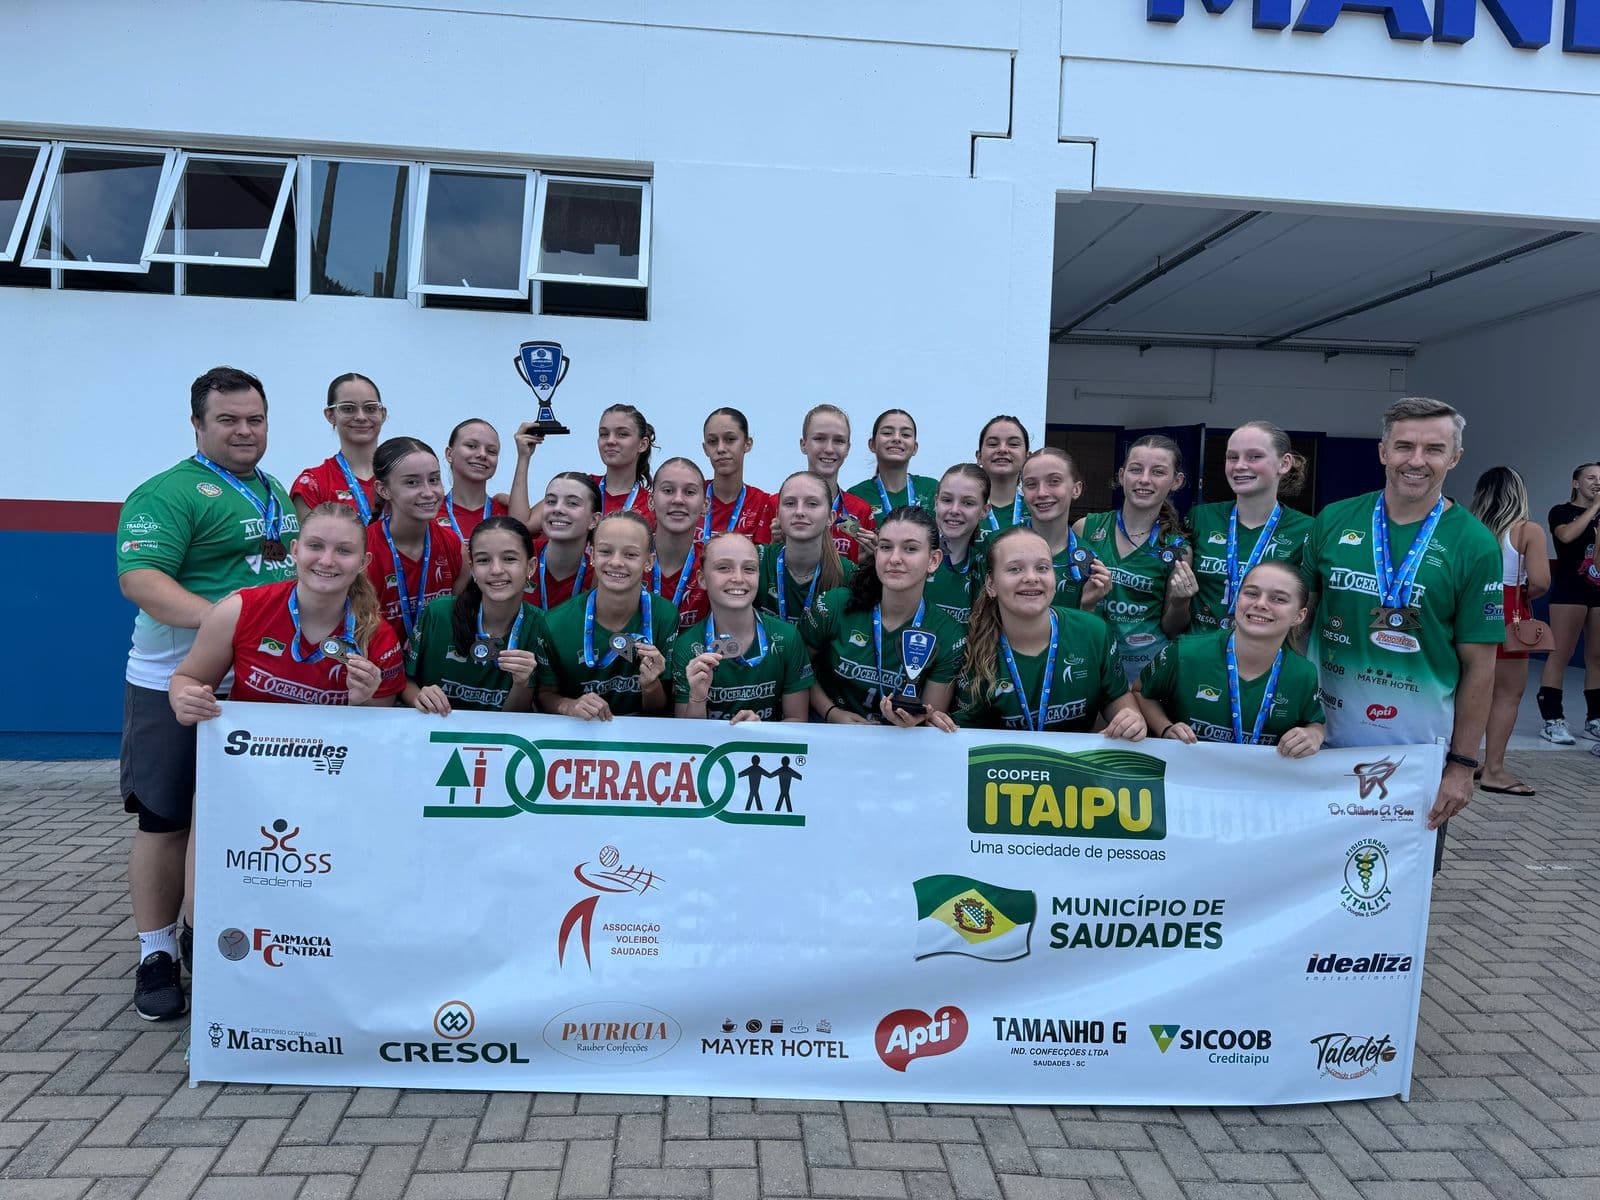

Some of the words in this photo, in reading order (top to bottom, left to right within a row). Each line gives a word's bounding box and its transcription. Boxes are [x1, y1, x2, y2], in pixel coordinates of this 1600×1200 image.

[1357, 673, 1388, 687] MAYER
[1390, 681, 1420, 693] HOTEL
[1369, 707, 1392, 717] Apti
[224, 730, 348, 759] Saudades
[252, 736, 324, 744] SUPERMERCADO
[987, 768, 1050, 782] COOPER
[985, 782, 1152, 832] ITAIPU
[970, 839, 1004, 855] Uma
[1007, 841, 1080, 858] sociedade
[1084, 845, 1103, 859] de
[1107, 848, 1166, 862] pessoas
[1346, 838, 1390, 857] FISIOTERAPIA
[242, 875, 313, 888] academia
[1051, 894, 1187, 917] MUNICÍPIO
[1192, 899, 1225, 916] DE
[1340, 885, 1392, 911] VITALITY
[602, 922, 661, 934] ASSOCIAÇÃO
[1049, 922, 1223, 950] SAUDADES
[253, 928, 332, 951] FARMACIA
[615, 935, 660, 944] VOLEIBOL
[263, 944, 334, 968] CENTRAL
[610, 947, 659, 956] SAUDADES
[1306, 953, 1412, 973] idealiza
[251, 1027, 287, 1035] ESCRITÓRIO
[562, 1021, 668, 1042] PATRICIA
[885, 1011, 951, 1055] Apti
[992, 1016, 1105, 1044] TAMANHO
[1112, 1021, 1127, 1044] G
[1180, 1029, 1272, 1051] SICOOB
[226, 1028, 344, 1055] Marschall
[576, 1042, 605, 1053] Rauber
[606, 1042, 649, 1055] Confecções
[701, 1038, 775, 1056] MAYER
[781, 1039, 849, 1059] HOTEL
[379, 1042, 530, 1064] CRESOL
[1010, 1047, 1027, 1056] IND.
[1029, 1046, 1087, 1058] CONFECÇÕES
[1088, 1048, 1109, 1057] LTDA
[1208, 1052, 1270, 1066] Creditaipu
[1033, 1059, 1070, 1067] SAUDADES
